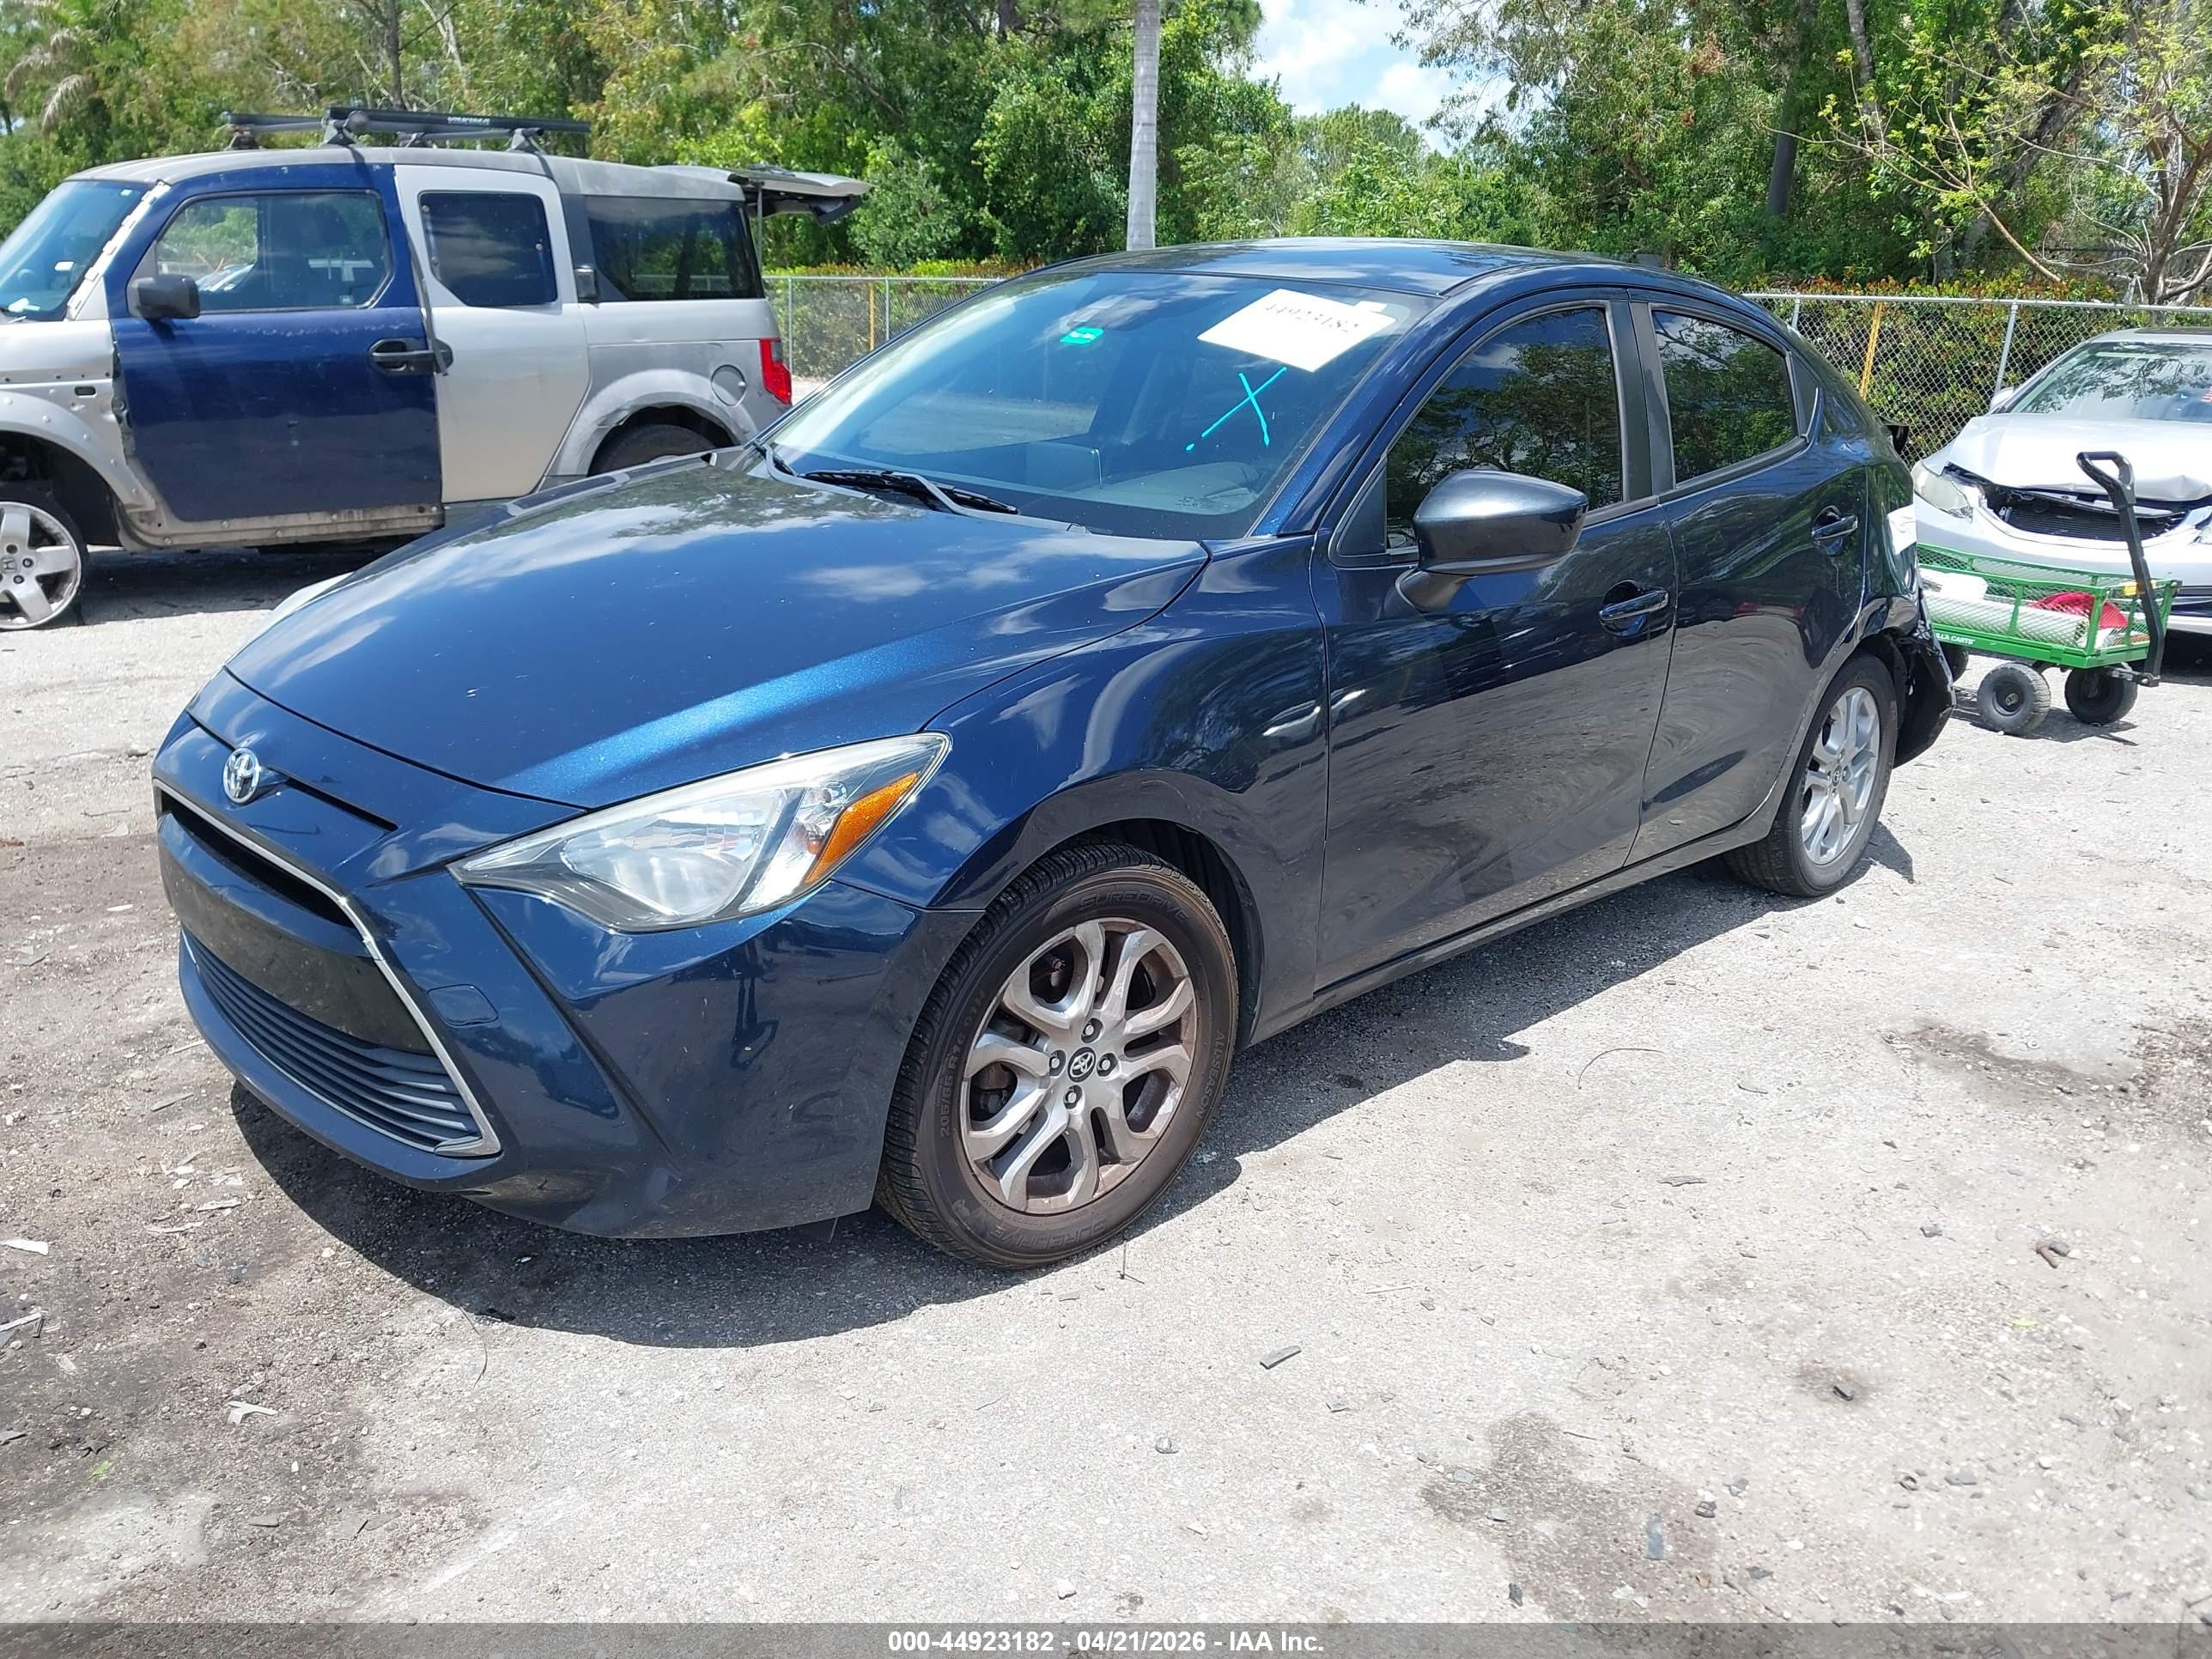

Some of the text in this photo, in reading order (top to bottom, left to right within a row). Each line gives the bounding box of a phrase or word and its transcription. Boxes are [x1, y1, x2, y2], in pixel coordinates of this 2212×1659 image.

[447, 116, 491, 126] YAKIMA
[1079, 890, 1190, 923] SUREDRIVE
[990, 1216, 1107, 1251] SUREDRIVE
